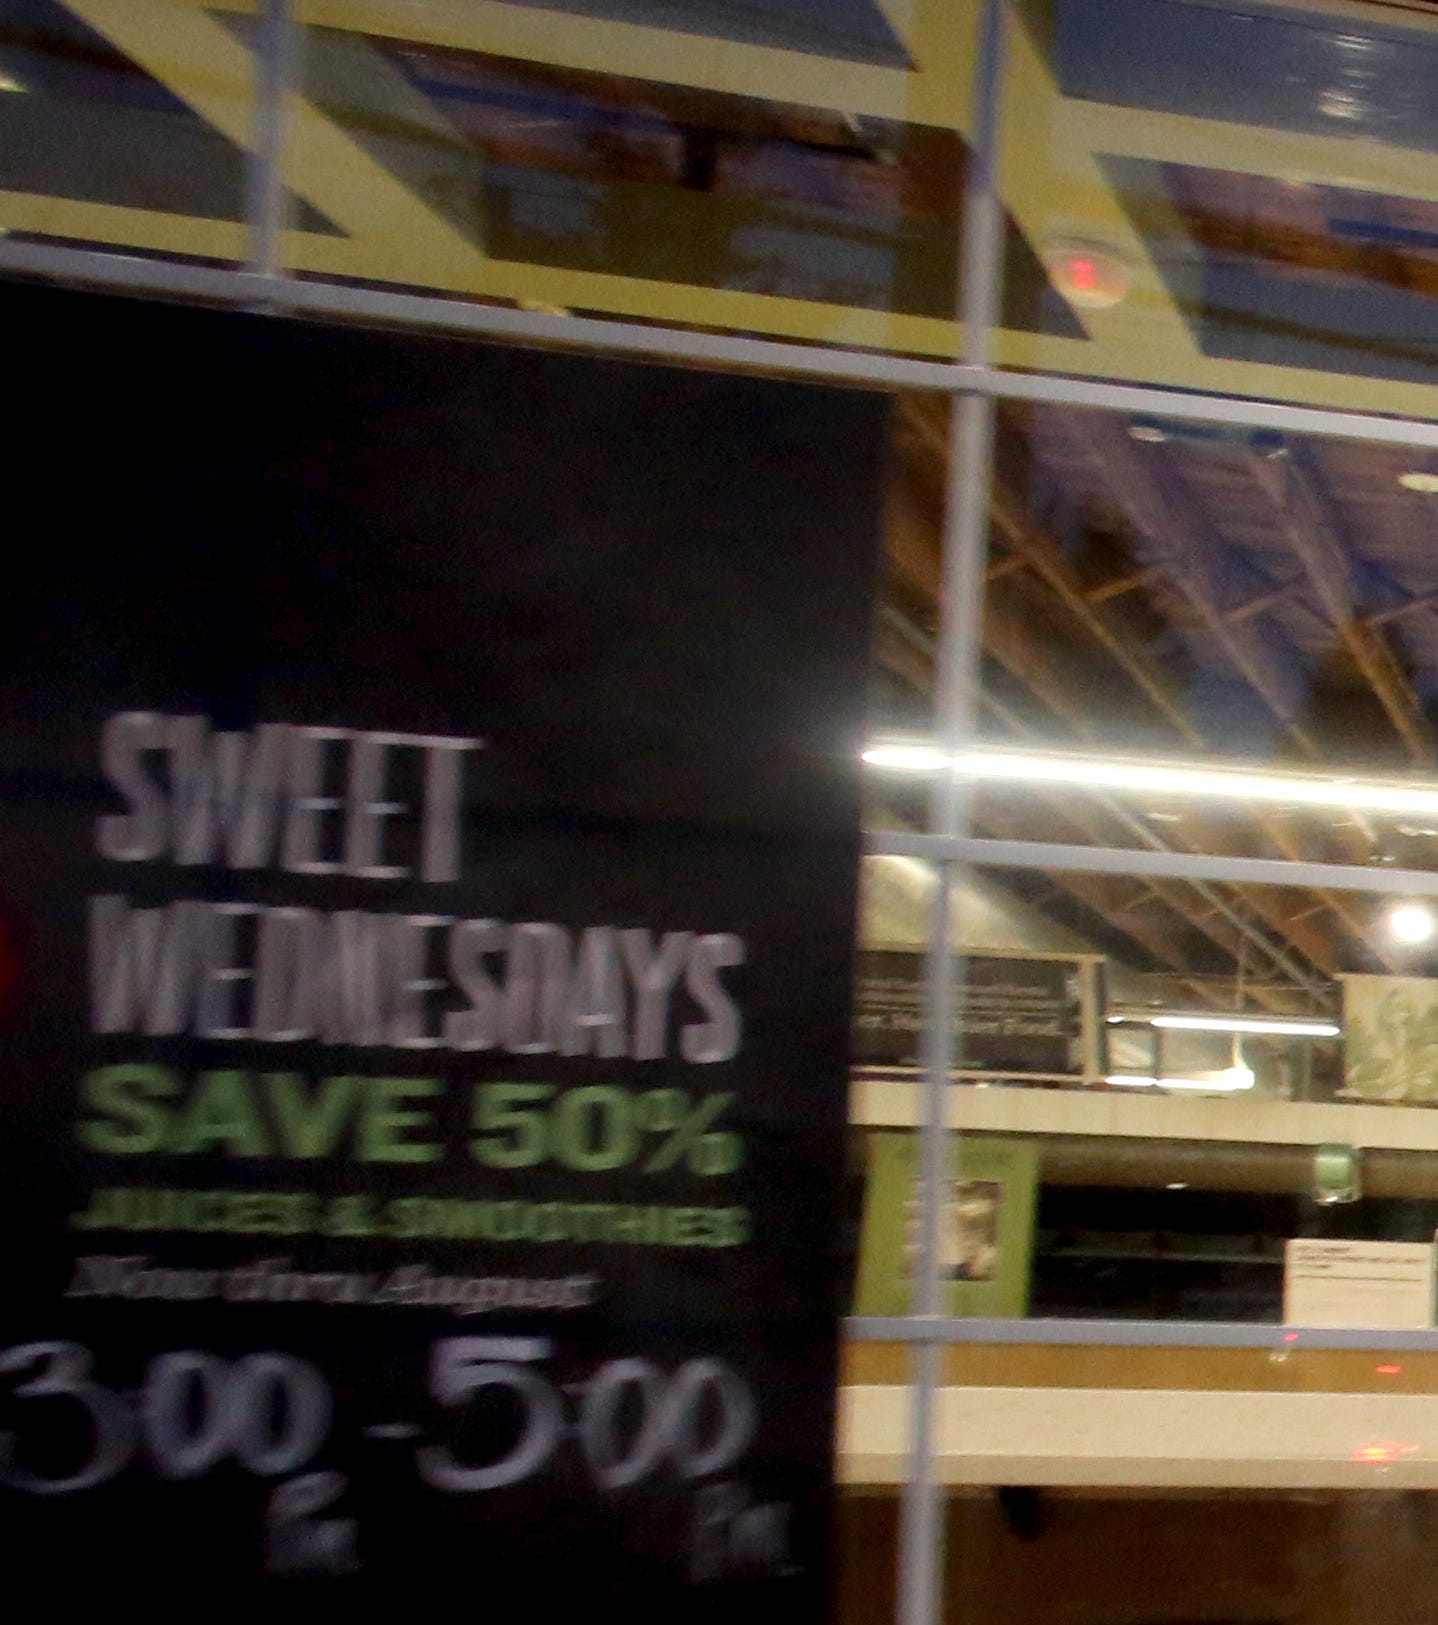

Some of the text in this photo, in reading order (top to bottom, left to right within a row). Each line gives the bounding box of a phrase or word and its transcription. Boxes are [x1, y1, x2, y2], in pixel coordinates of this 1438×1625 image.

[97, 709, 486, 883] SWEET
[88, 894, 746, 1065] WEDNESDAYS
[75, 1062, 748, 1178] SAVE 50%
